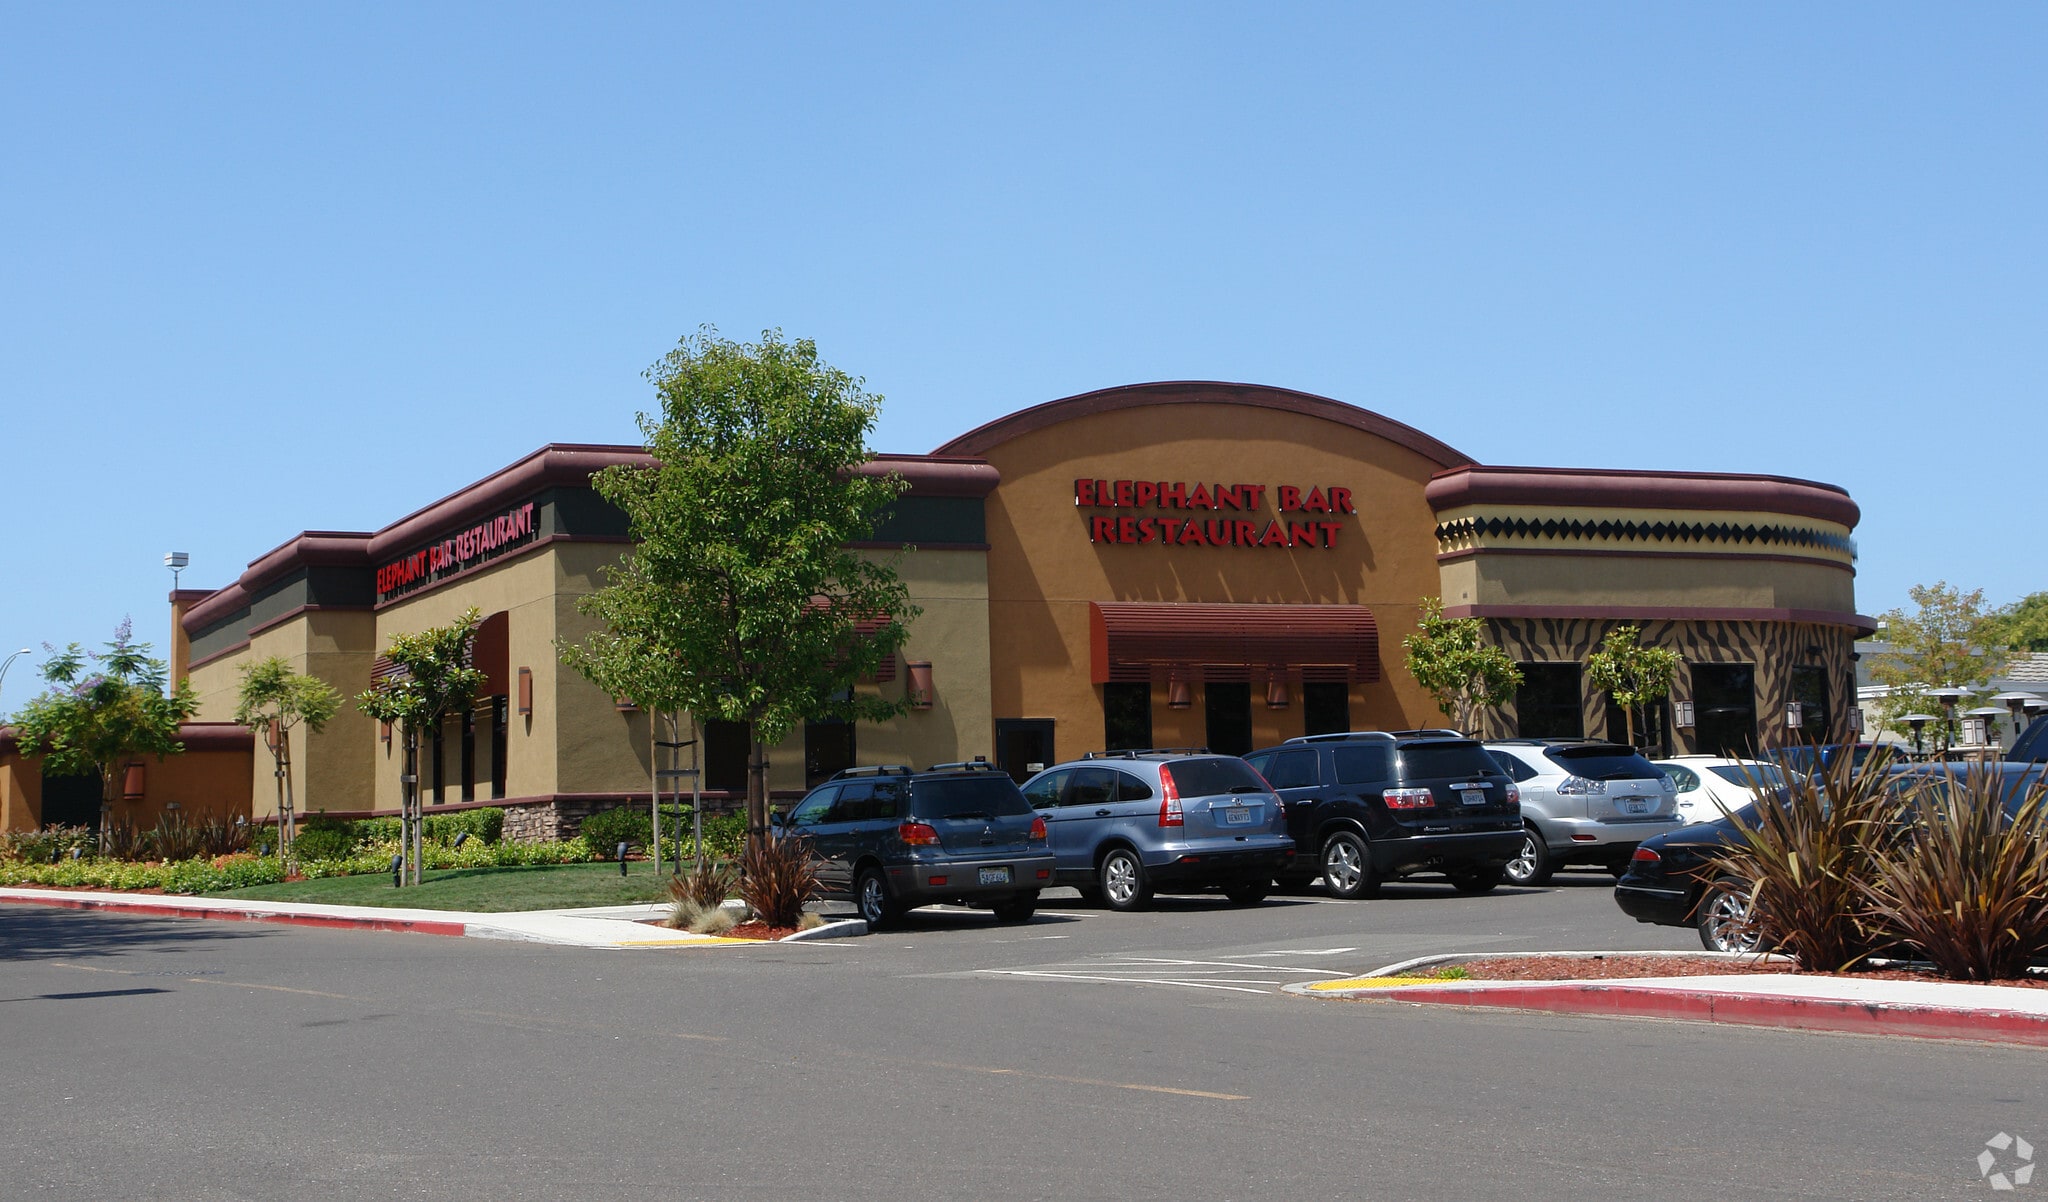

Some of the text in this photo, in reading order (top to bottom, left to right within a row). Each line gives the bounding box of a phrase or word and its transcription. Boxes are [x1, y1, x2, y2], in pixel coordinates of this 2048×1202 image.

[1075, 478, 1357, 514] ELEPHANT BAR
[376, 502, 534, 595] ELEPHANT BAR RESTAURANT
[1090, 515, 1343, 548] RESTAURANT
